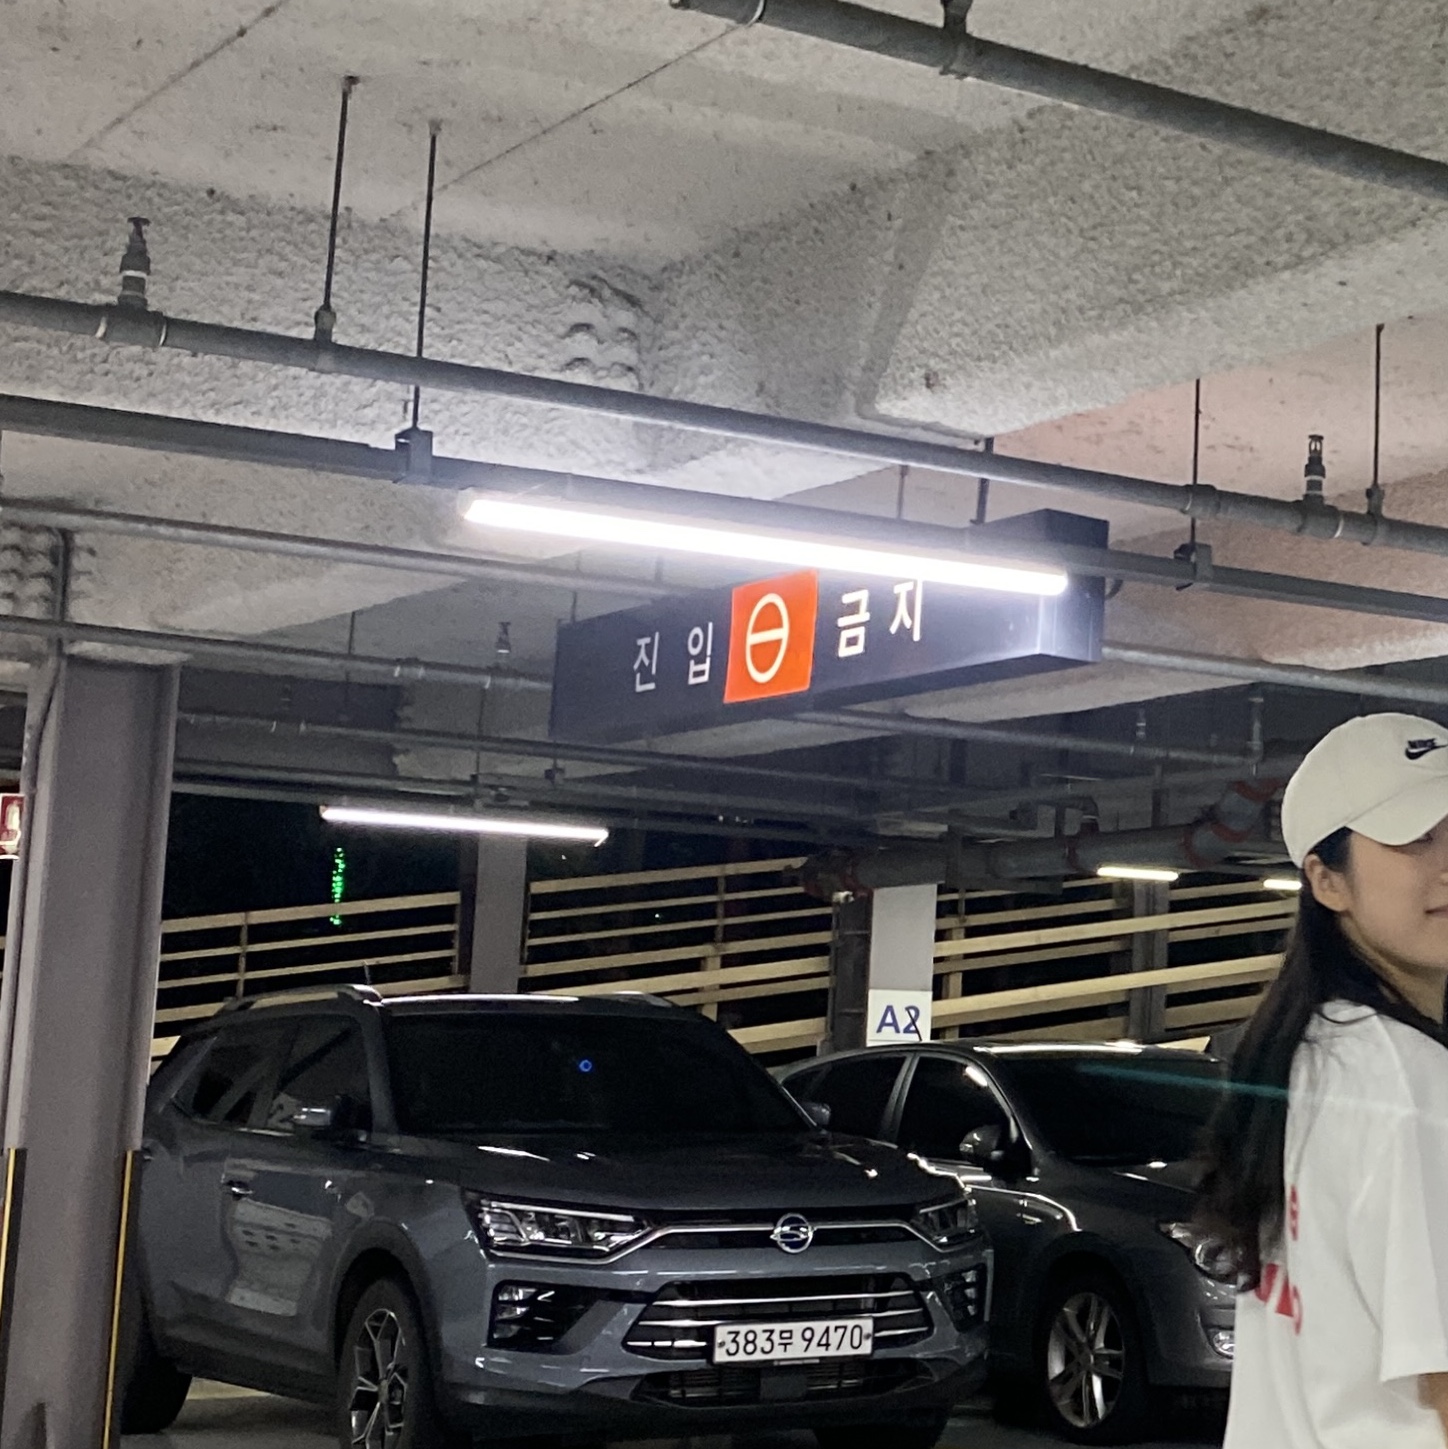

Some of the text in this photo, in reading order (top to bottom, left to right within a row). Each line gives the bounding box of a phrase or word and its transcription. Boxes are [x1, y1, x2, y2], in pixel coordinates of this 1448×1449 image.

[632, 578, 925, 693] 진입 금지
[876, 1004, 921, 1034] A2
[725, 1324, 864, 1357] 383무 9470
